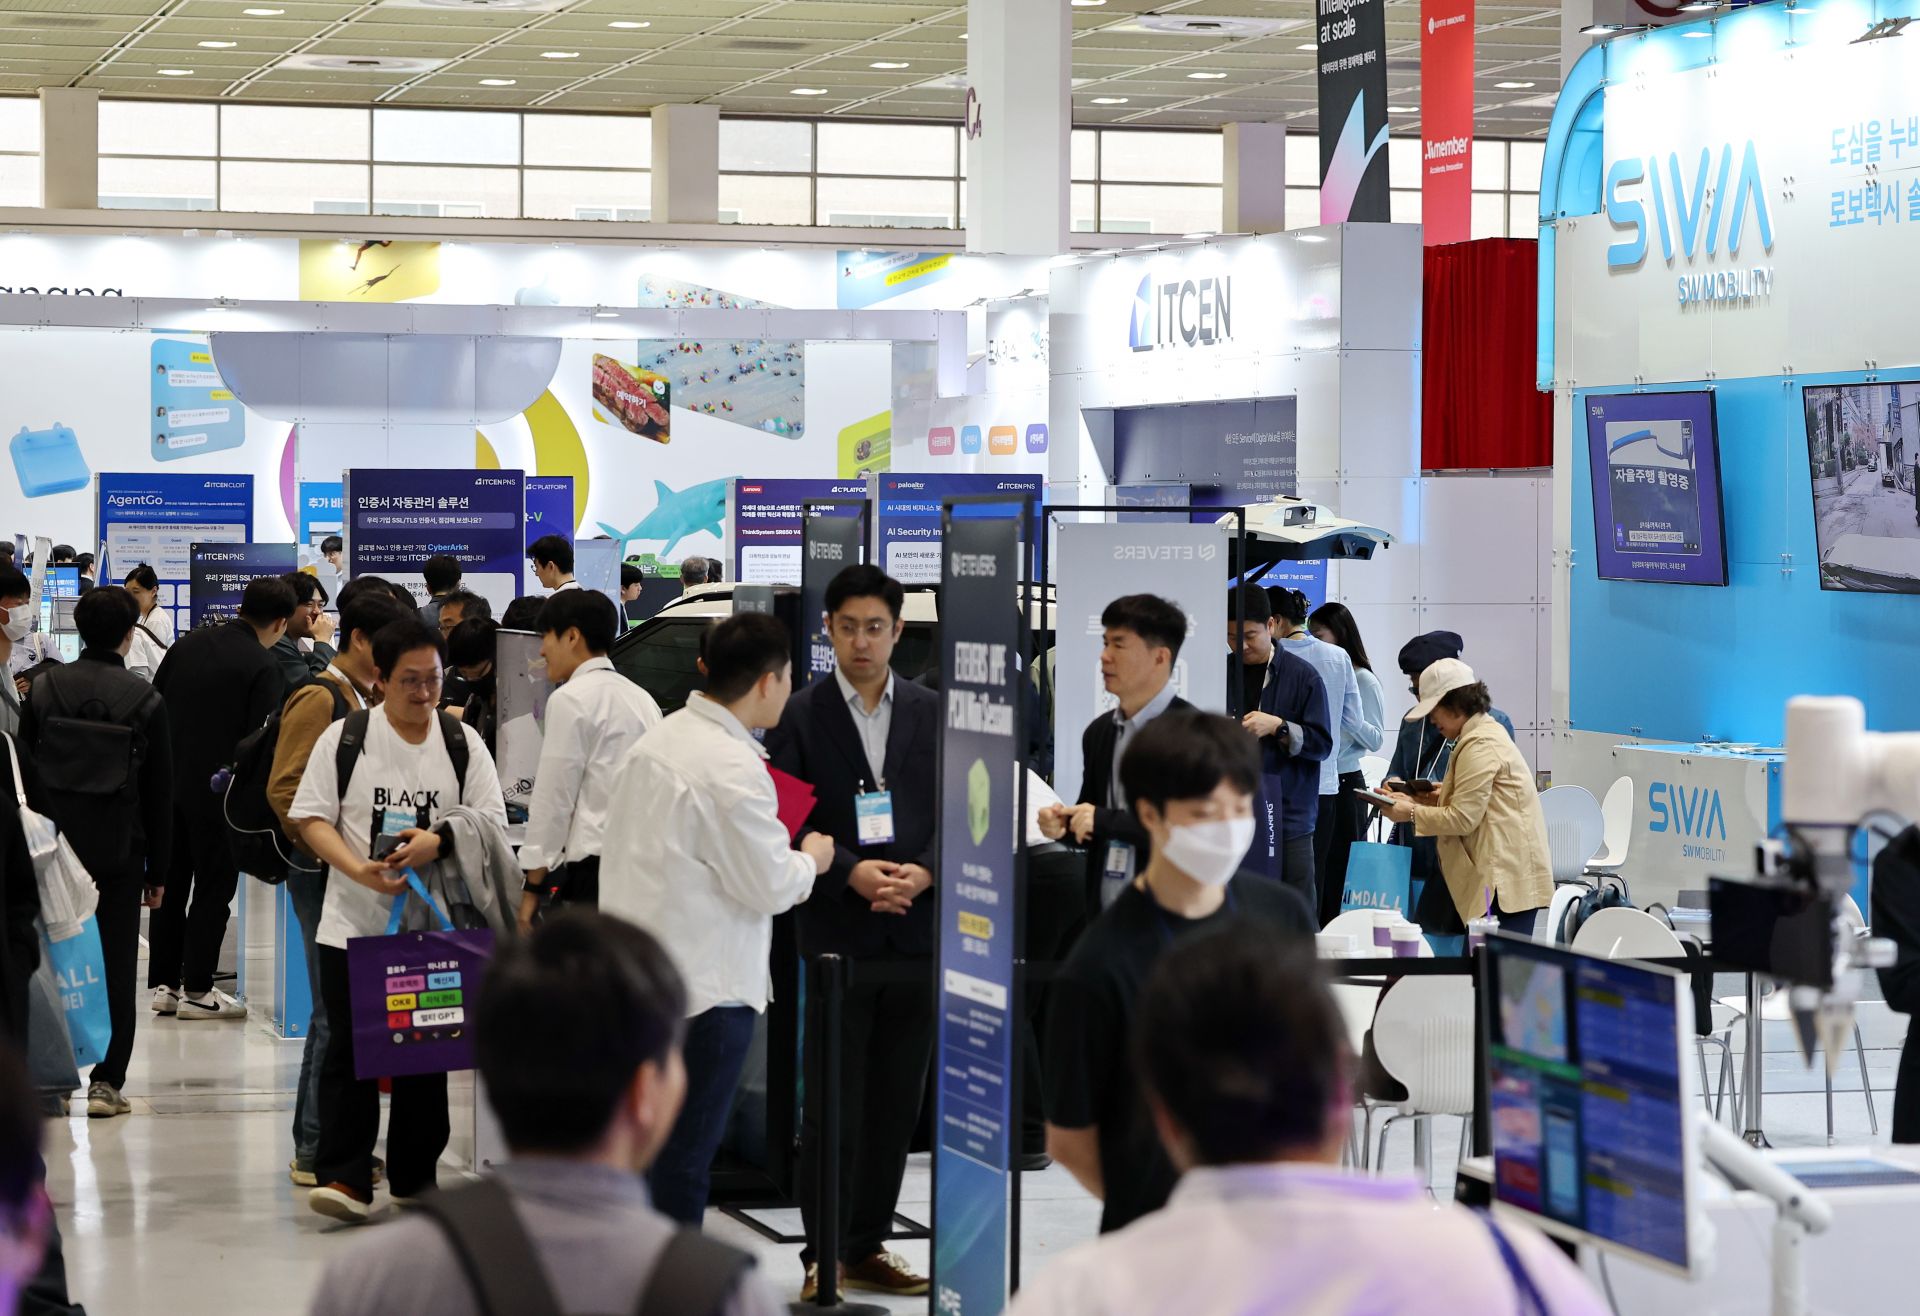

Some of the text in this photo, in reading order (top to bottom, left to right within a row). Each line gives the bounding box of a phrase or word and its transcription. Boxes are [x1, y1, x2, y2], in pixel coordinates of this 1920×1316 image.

[1320, 14, 1356, 43] at scale
[1830, 120, 1882, 165] 도심을
[1829, 179, 1900, 227] 로보택시
[1703, 267, 1774, 302] MOBILITY
[1157, 275, 1231, 346] ITCEN
[616, 390, 647, 408] 예약하기
[1616, 468, 1690, 490] 자율주행 촬영중
[107, 494, 163, 506] AgentGo
[308, 498, 329, 508] 추가
[358, 497, 469, 509] 인증서 자동관리 솔루션
[898, 528, 931, 537] Security
[817, 543, 843, 560] ETEVERS
[374, 787, 439, 808] BLACK
[1695, 846, 1726, 862] MOBILITY
[438, 1012, 456, 1020] GPT
